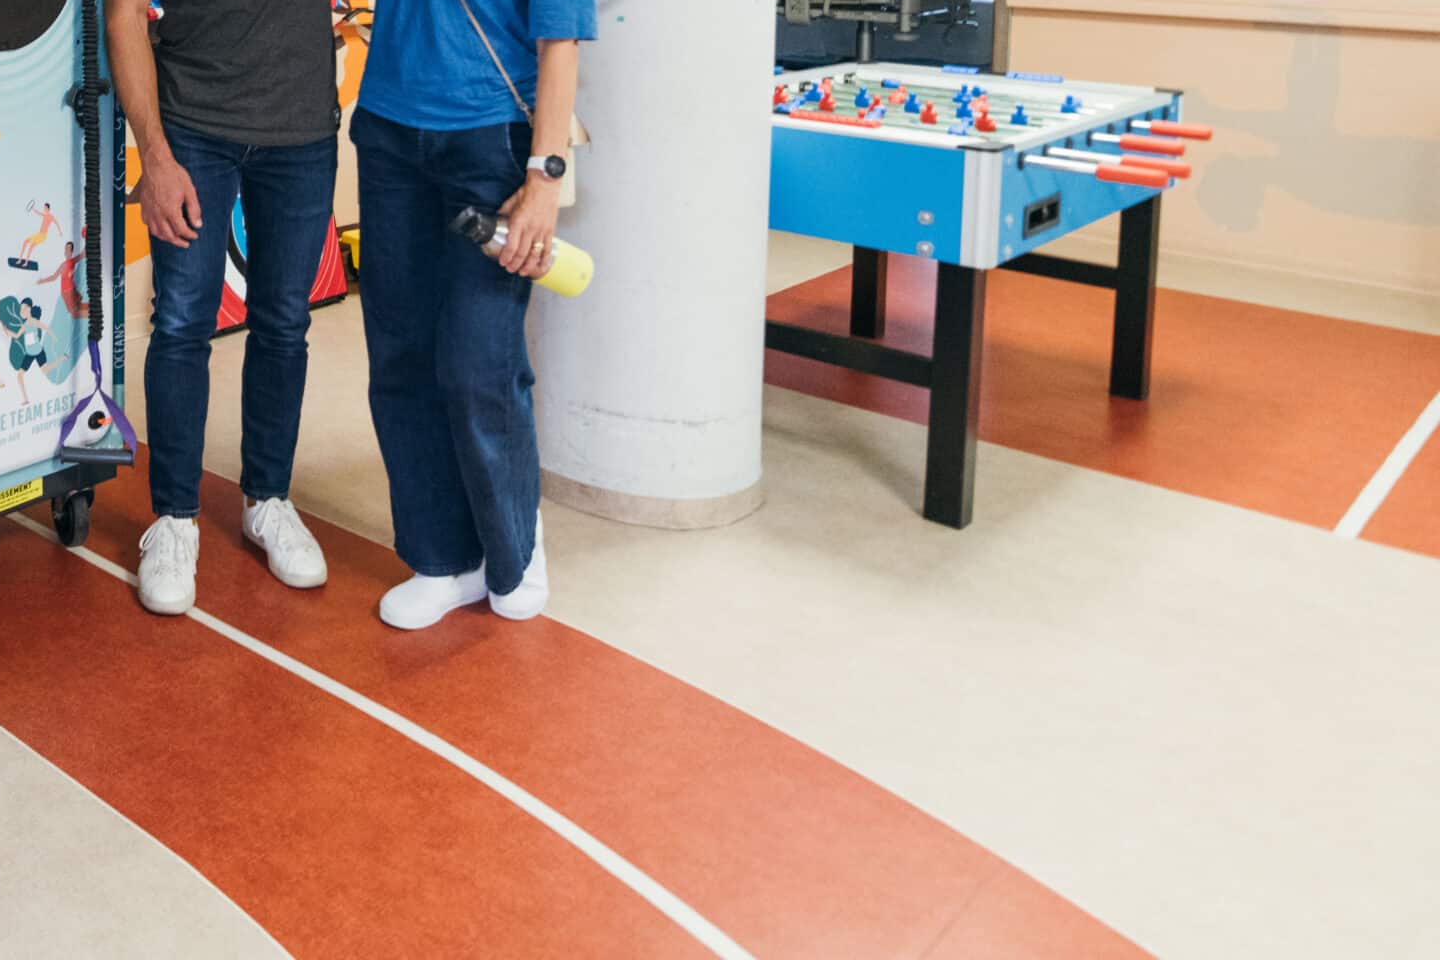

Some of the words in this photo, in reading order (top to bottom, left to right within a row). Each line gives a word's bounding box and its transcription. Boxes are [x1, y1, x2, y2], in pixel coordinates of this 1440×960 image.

[113, 323, 125, 369] OCEANS
[10, 403, 43, 426] TEAM
[46, 392, 76, 415] EAST
